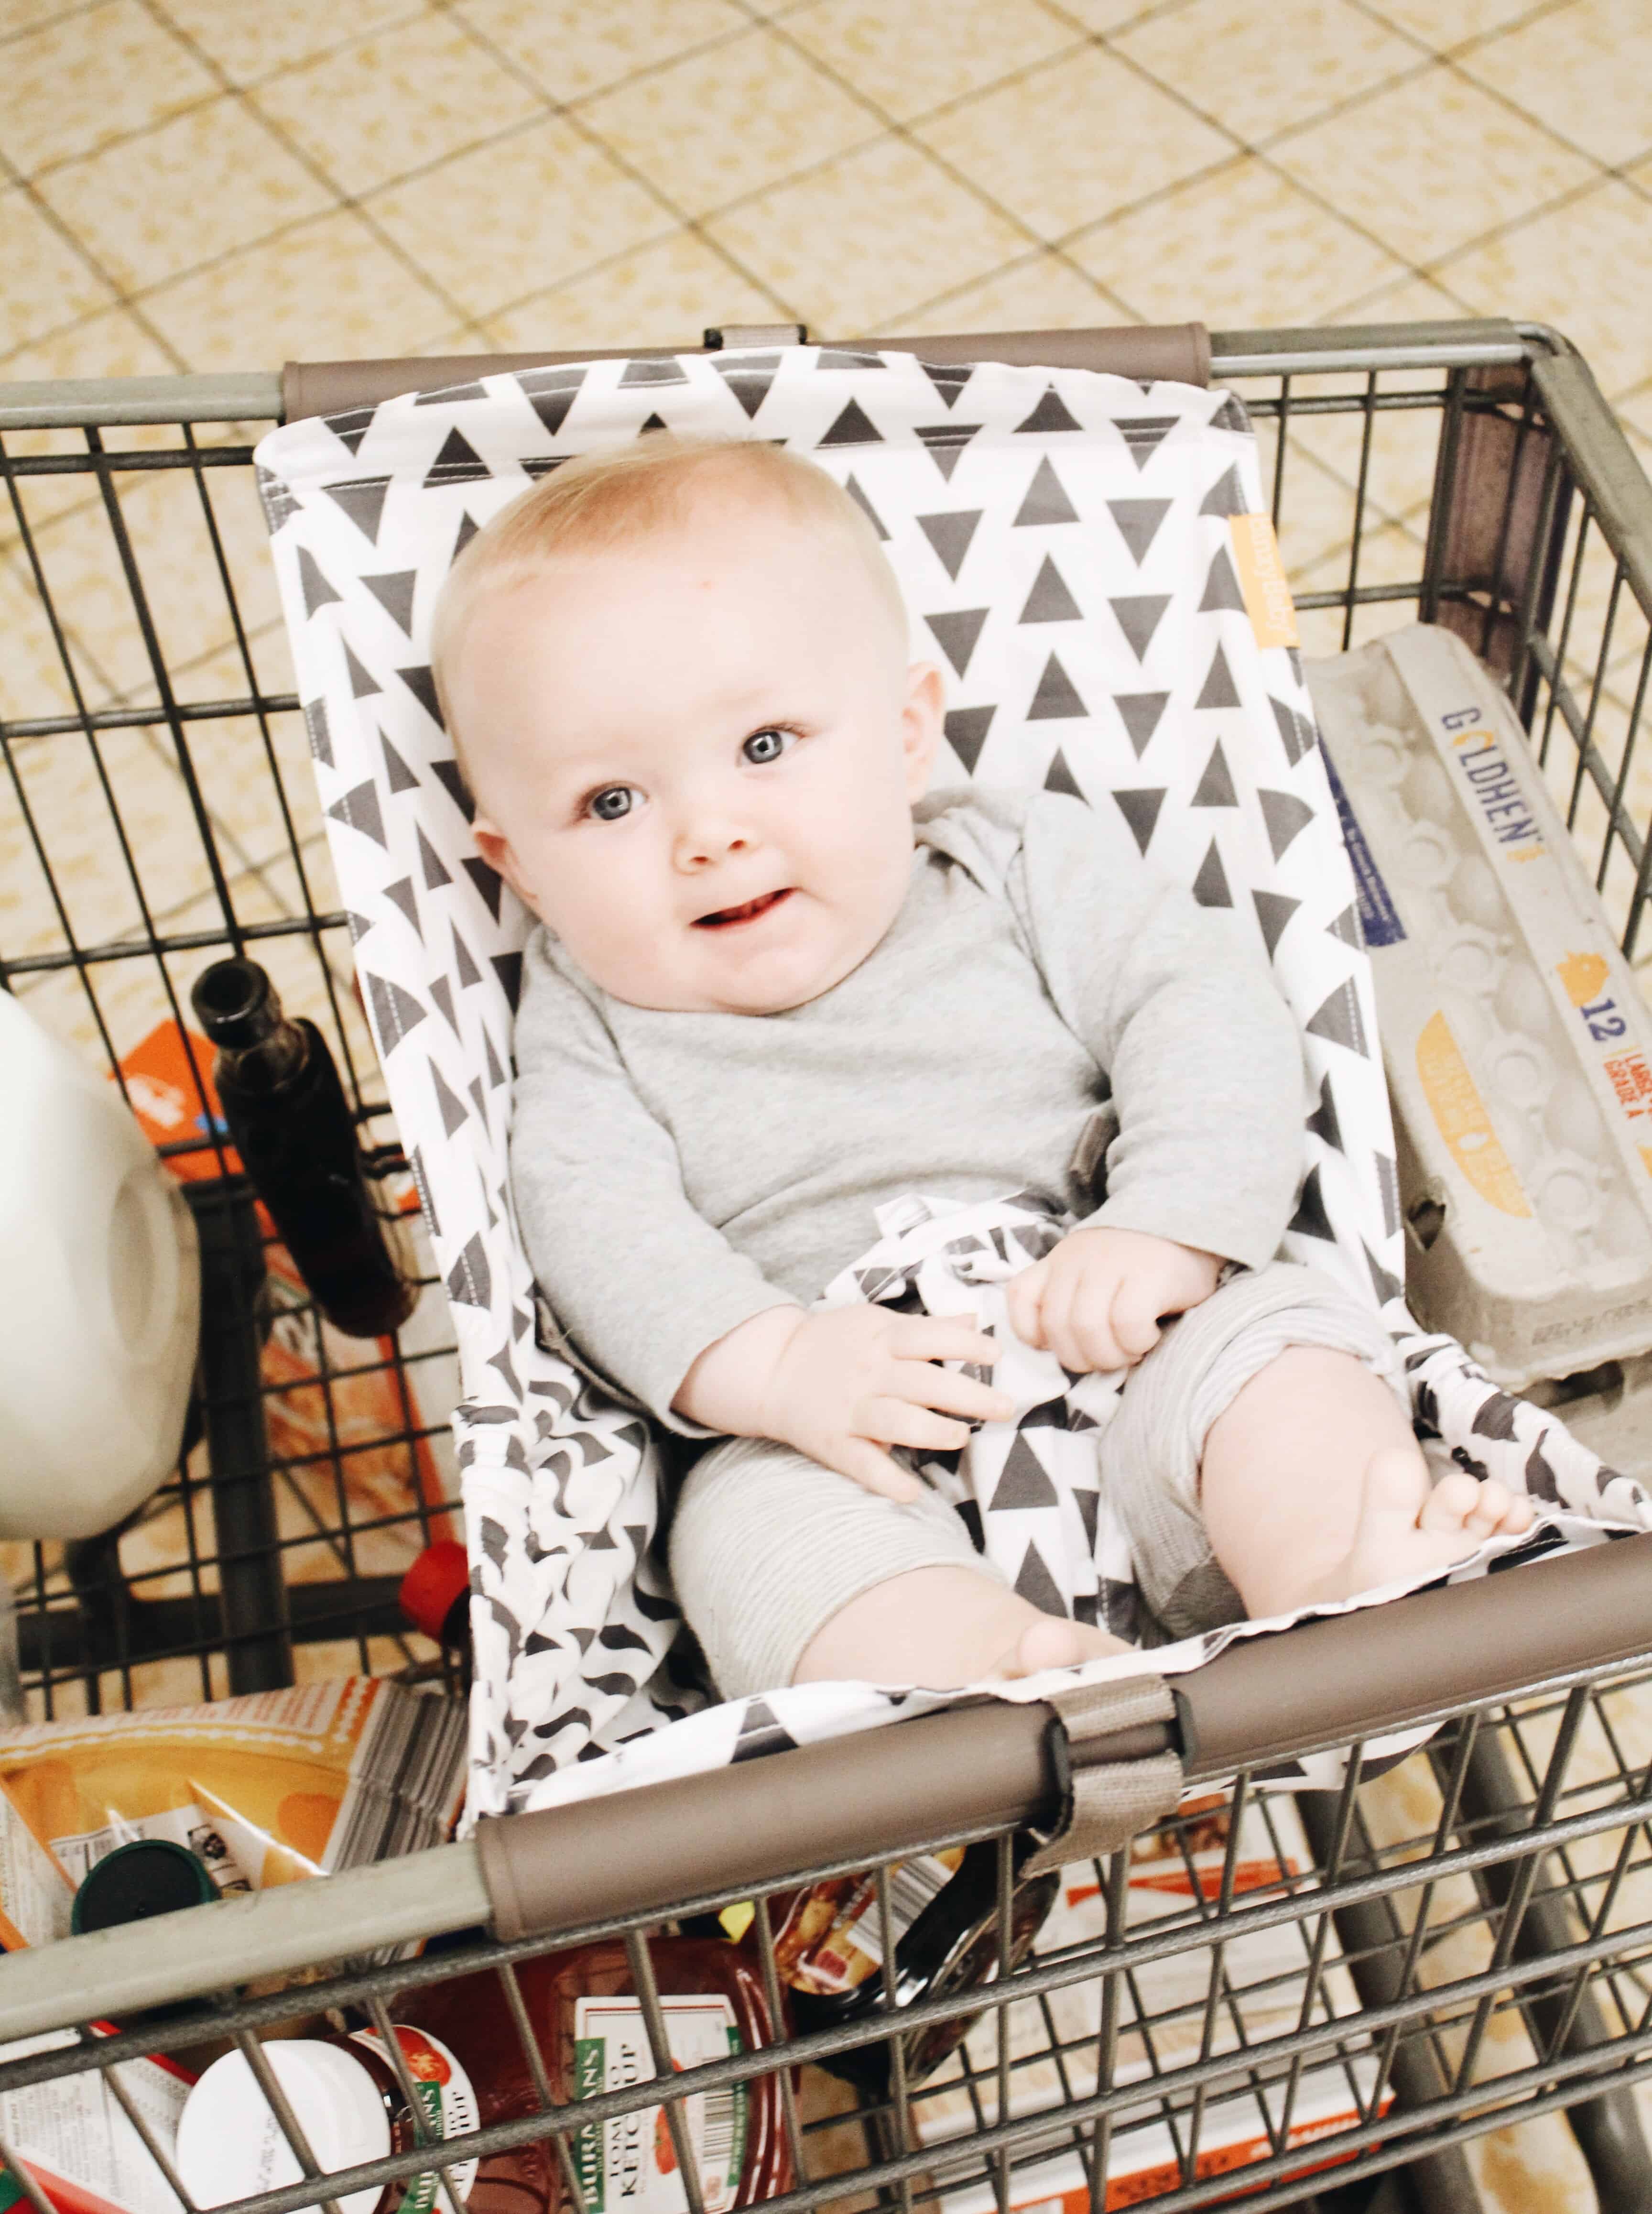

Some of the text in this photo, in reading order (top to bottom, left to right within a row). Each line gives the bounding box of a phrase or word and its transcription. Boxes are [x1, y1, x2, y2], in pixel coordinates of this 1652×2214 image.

[1580, 998, 1627, 1041] 12
[1626, 1108, 1645, 1120] A
[609, 2065, 622, 2179] TOMO
[620, 2043, 640, 2198] KETCUP
